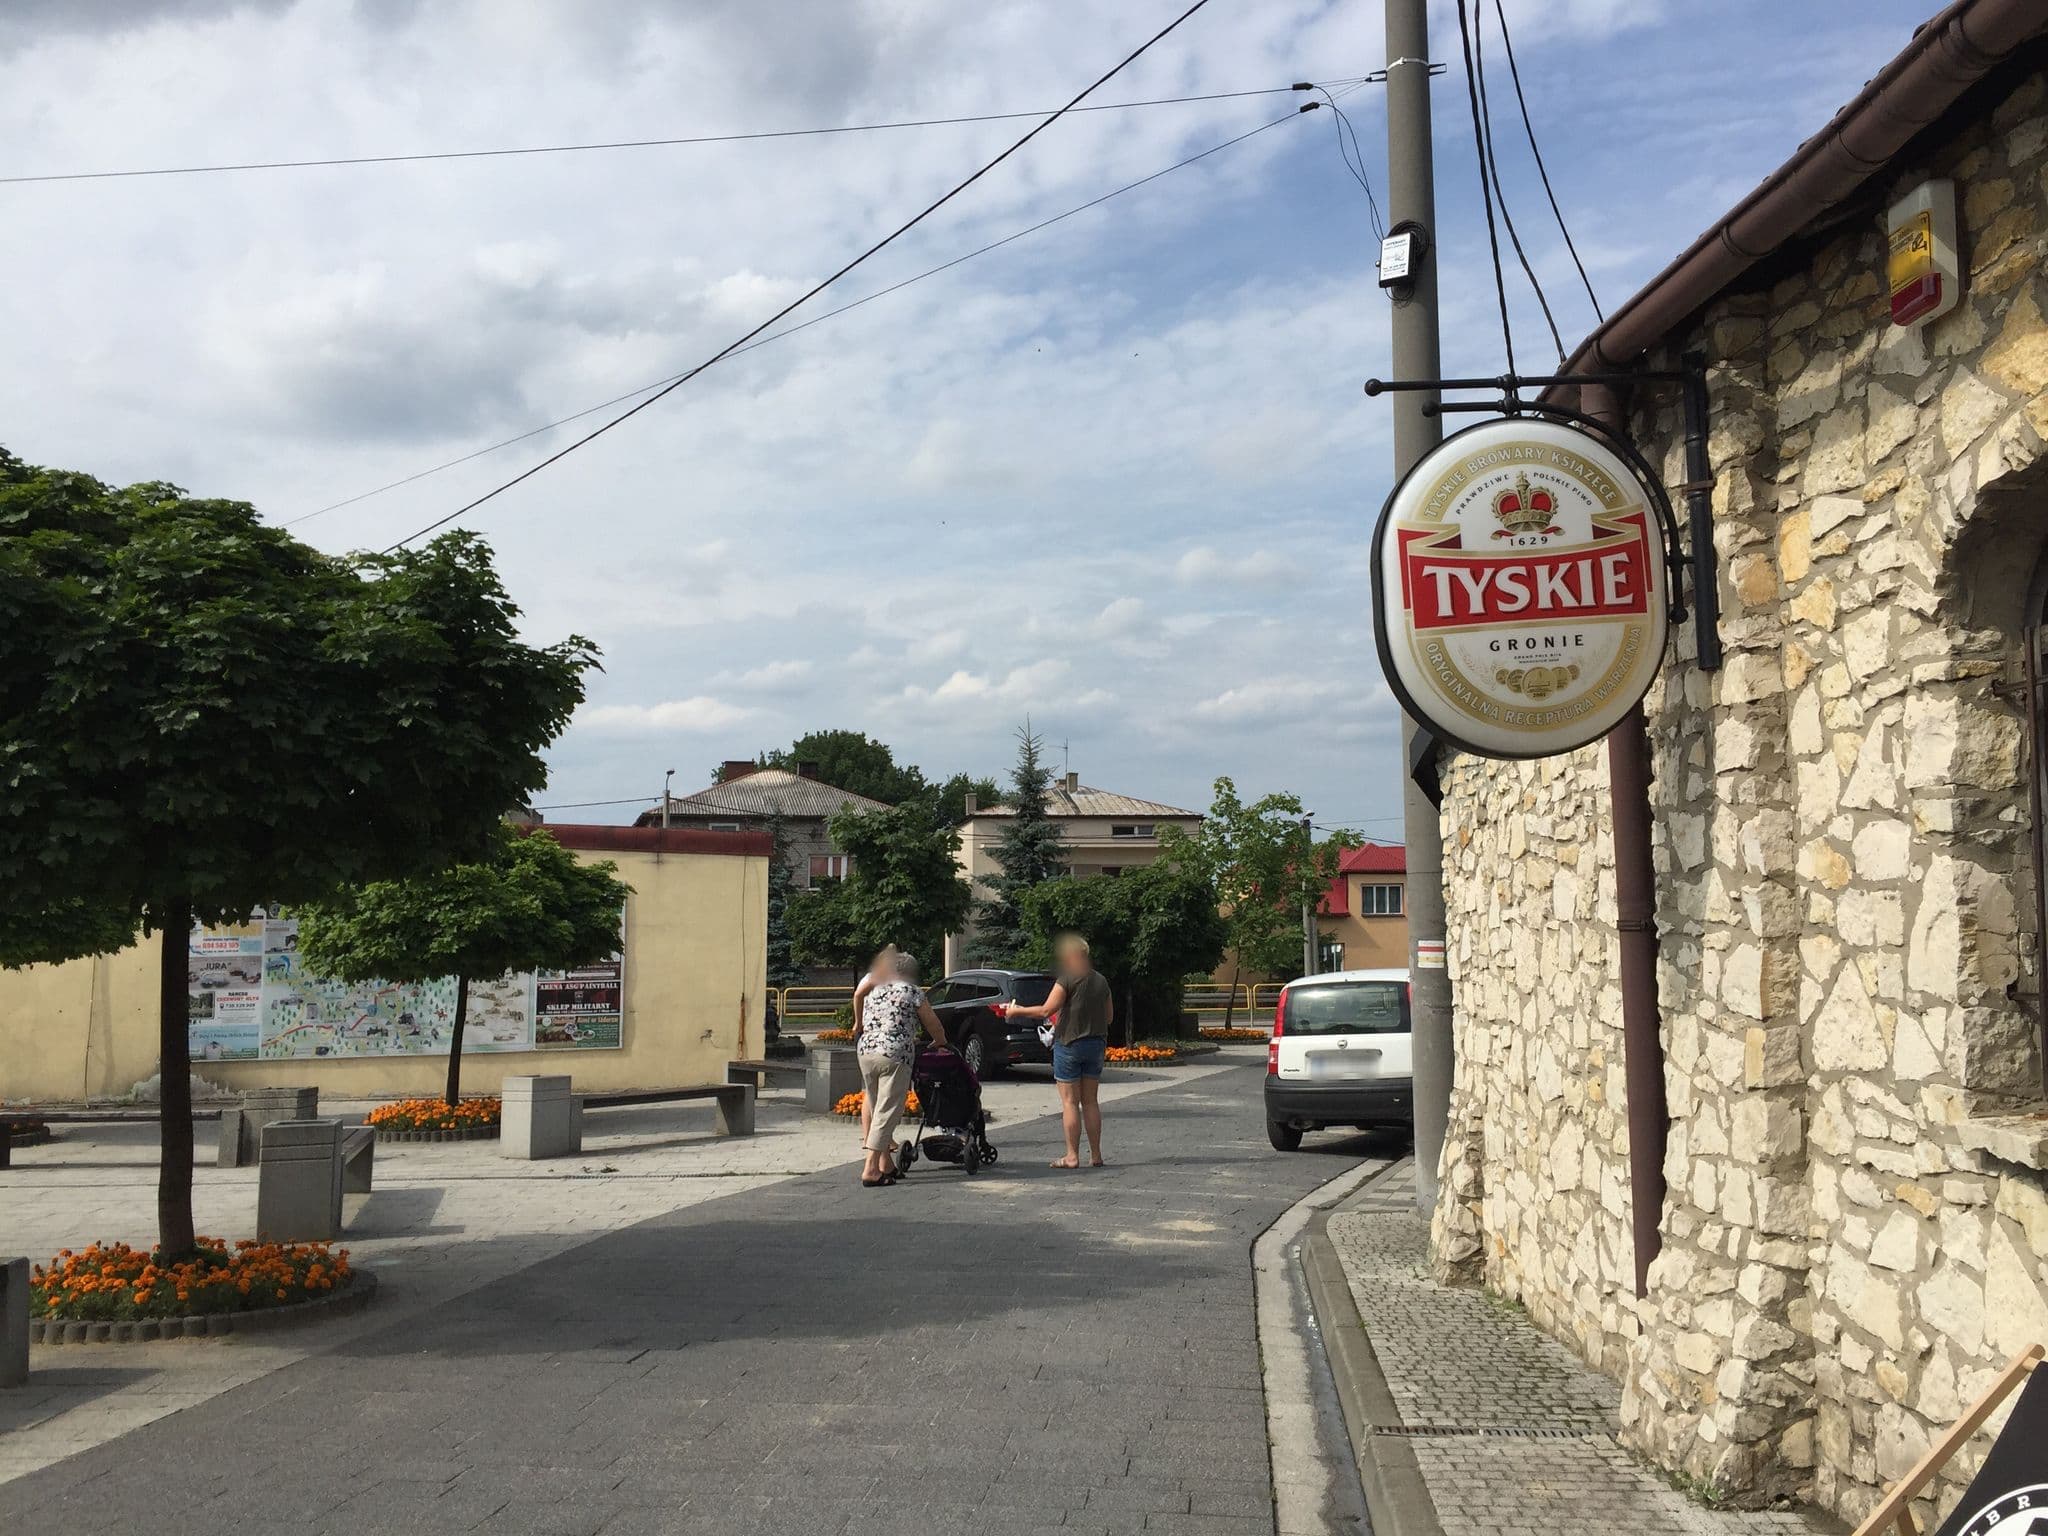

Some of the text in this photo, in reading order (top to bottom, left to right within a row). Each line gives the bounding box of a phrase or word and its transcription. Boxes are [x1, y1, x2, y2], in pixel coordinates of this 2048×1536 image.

[1424, 470, 1466, 517] TYSKIE
[1466, 447, 1545, 474] BROWARY
[1456, 472, 1593, 515] PRAWDZIWE POLSKIE PIWO
[1510, 536, 1549, 547] 1629
[1422, 551, 1634, 618] TYSKIE
[1489, 634, 1585, 652] GRONIE
[1425, 625, 1642, 725] ORYGINALNA RECEPTURA WARZENIA
